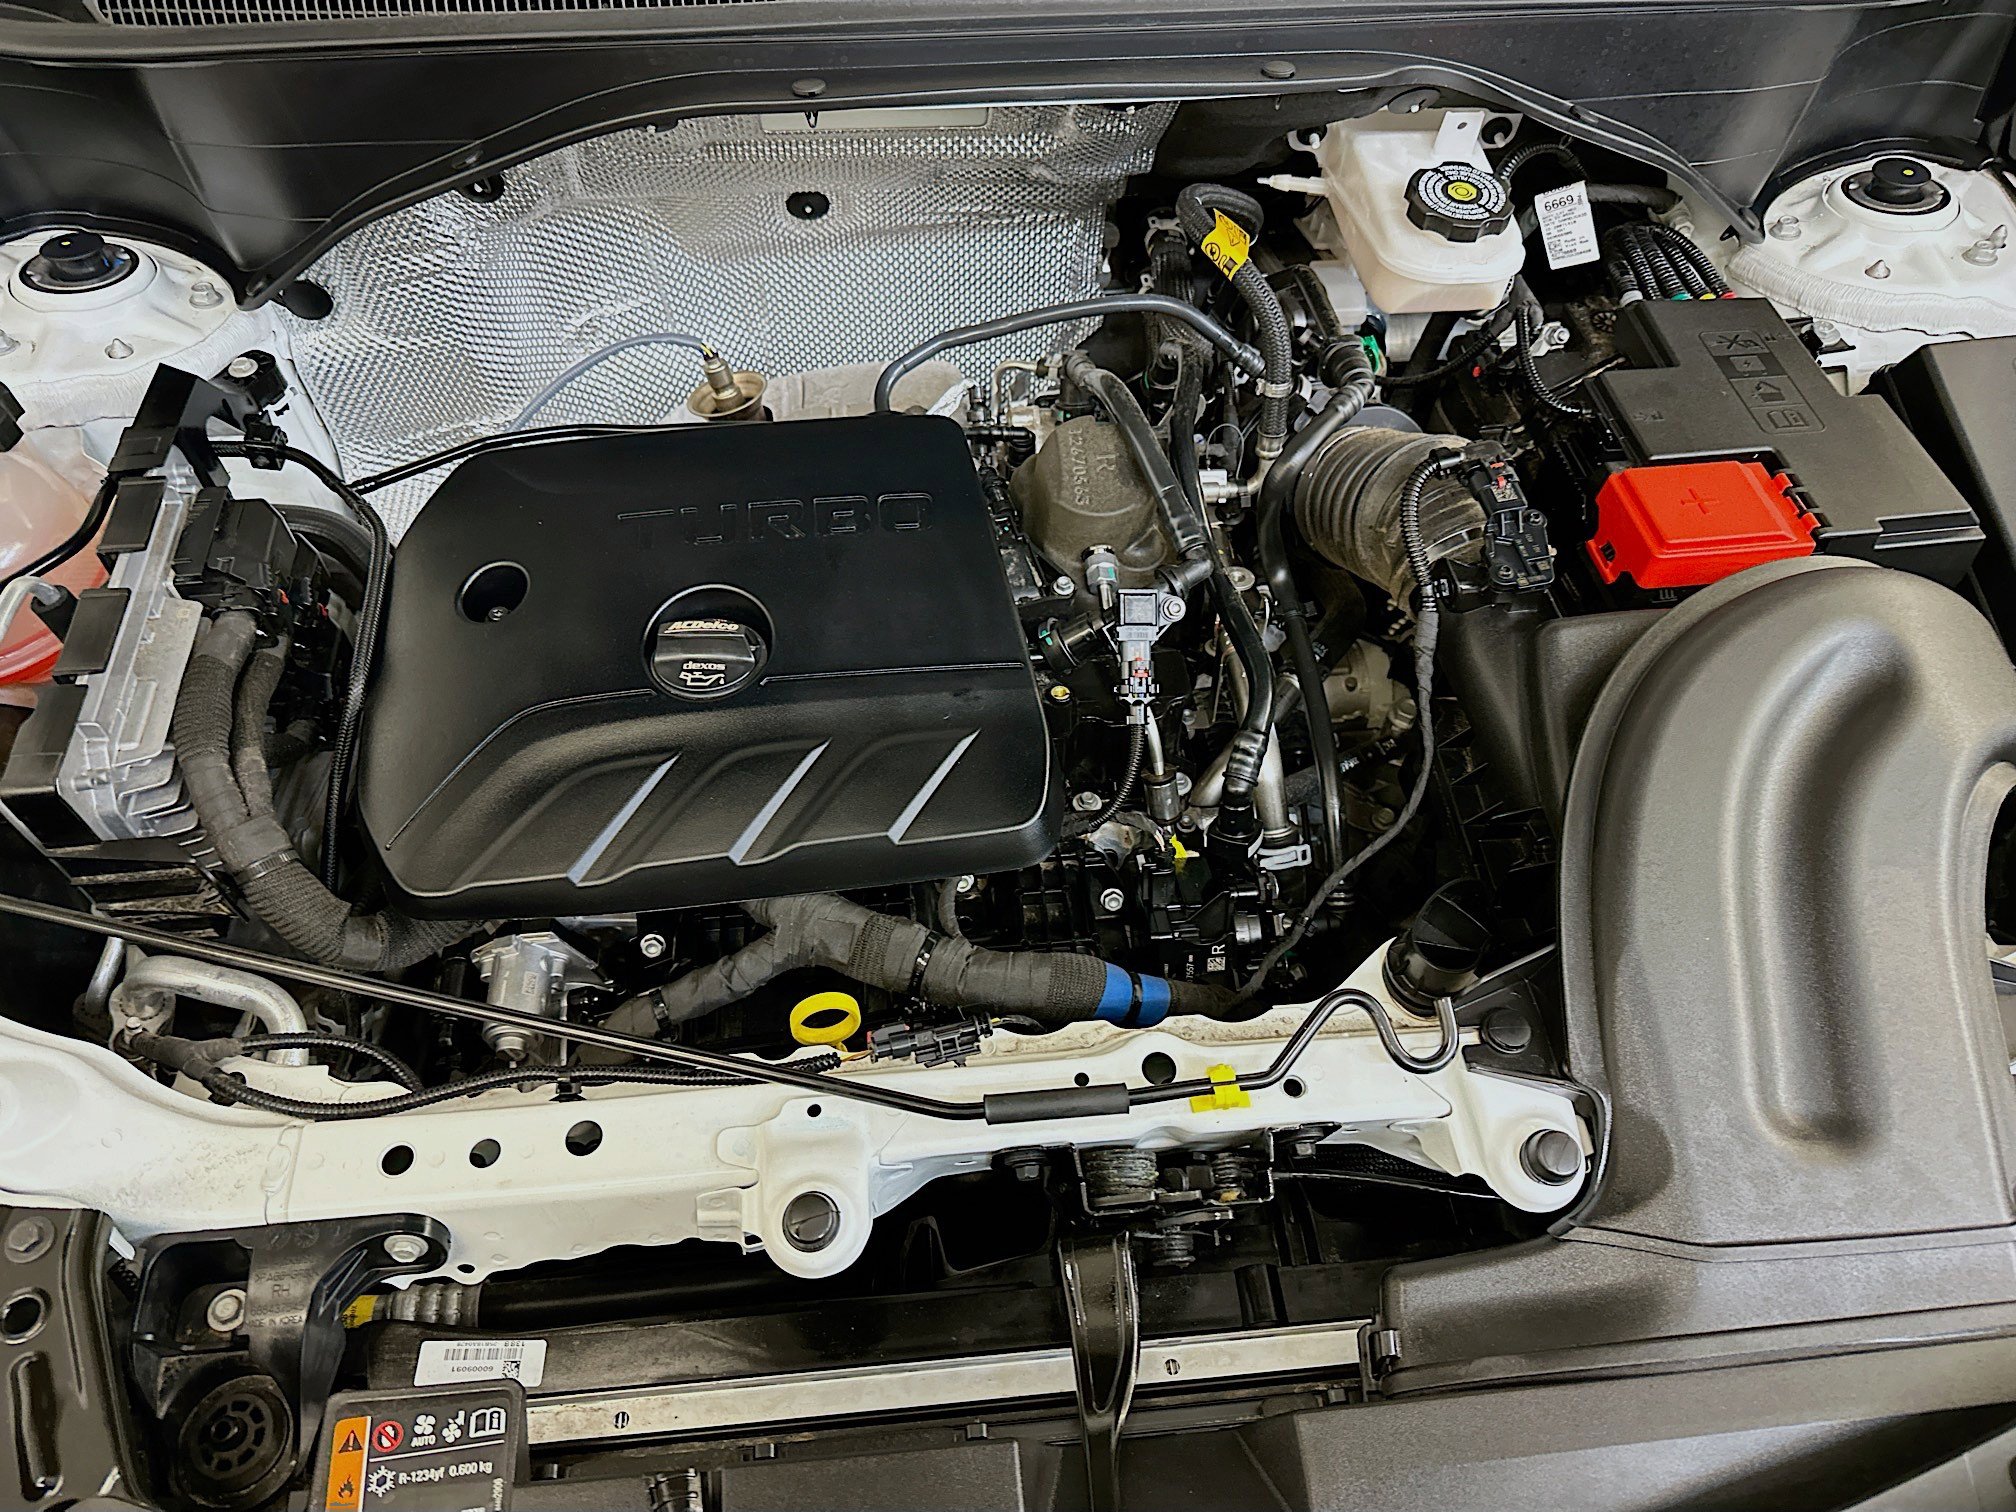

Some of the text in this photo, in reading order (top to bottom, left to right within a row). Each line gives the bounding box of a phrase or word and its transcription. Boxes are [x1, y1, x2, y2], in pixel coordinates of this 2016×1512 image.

[1544, 194, 1574, 212] 6669
[617, 492, 933, 548] TURBO
[666, 620, 740, 632] ACDelco
[682, 661, 726, 671] dexos
[1211, 944, 1226, 955] R
[272, 1283, 291, 1298] RH
[410, 1434, 436, 1448] AUTO
[398, 1460, 493, 1485] R-1234yf 0.600 kg
